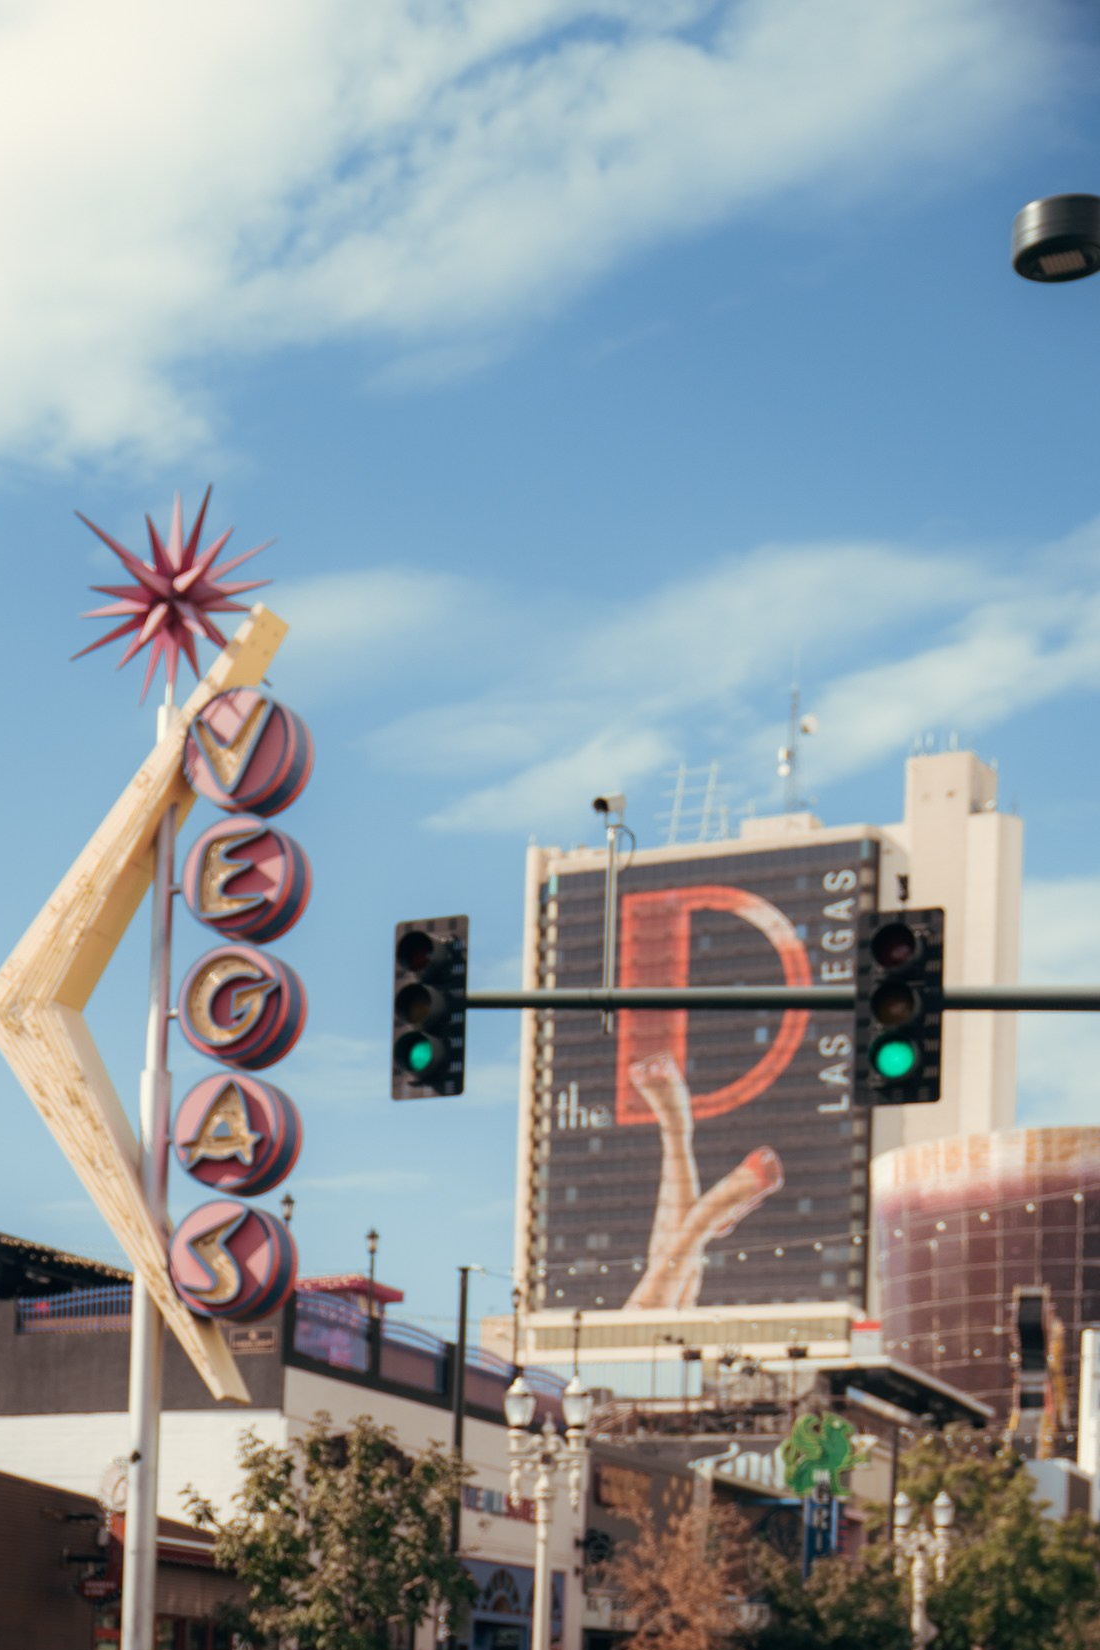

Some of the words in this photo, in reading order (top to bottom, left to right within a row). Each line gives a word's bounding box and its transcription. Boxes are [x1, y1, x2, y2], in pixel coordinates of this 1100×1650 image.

[180, 699, 281, 1303] VEGAS
[556, 1080, 612, 1130] the
[615, 884, 813, 1127] D
[820, 868, 857, 983] EGAS
[817, 1033, 851, 1114] LAS
